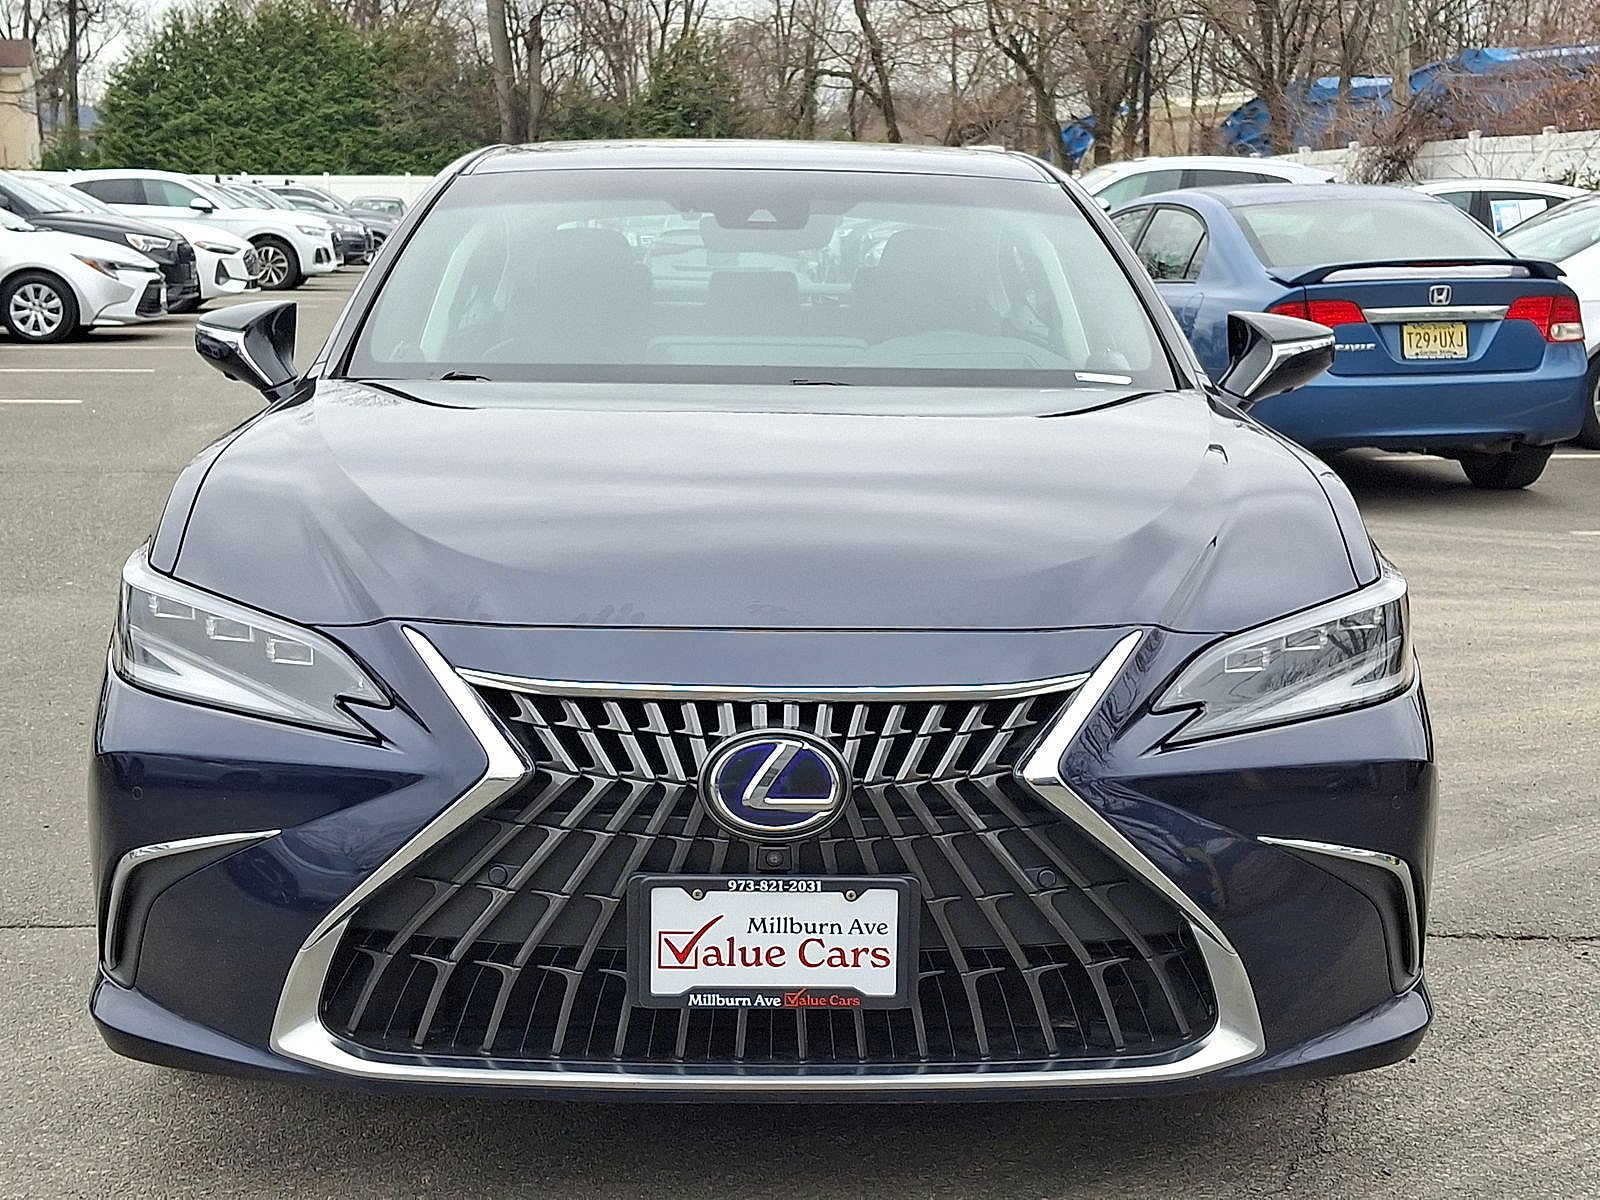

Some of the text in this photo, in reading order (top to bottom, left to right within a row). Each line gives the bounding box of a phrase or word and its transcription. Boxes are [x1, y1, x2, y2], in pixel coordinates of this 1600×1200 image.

[727, 880, 822, 892] 973-821-2031
[747, 917, 889, 935] Millburn Ave
[798, 938, 891, 968] Cars
[688, 993, 751, 1006] Millburn
[754, 994, 782, 1006] Ave
[829, 994, 861, 1006] Cars
